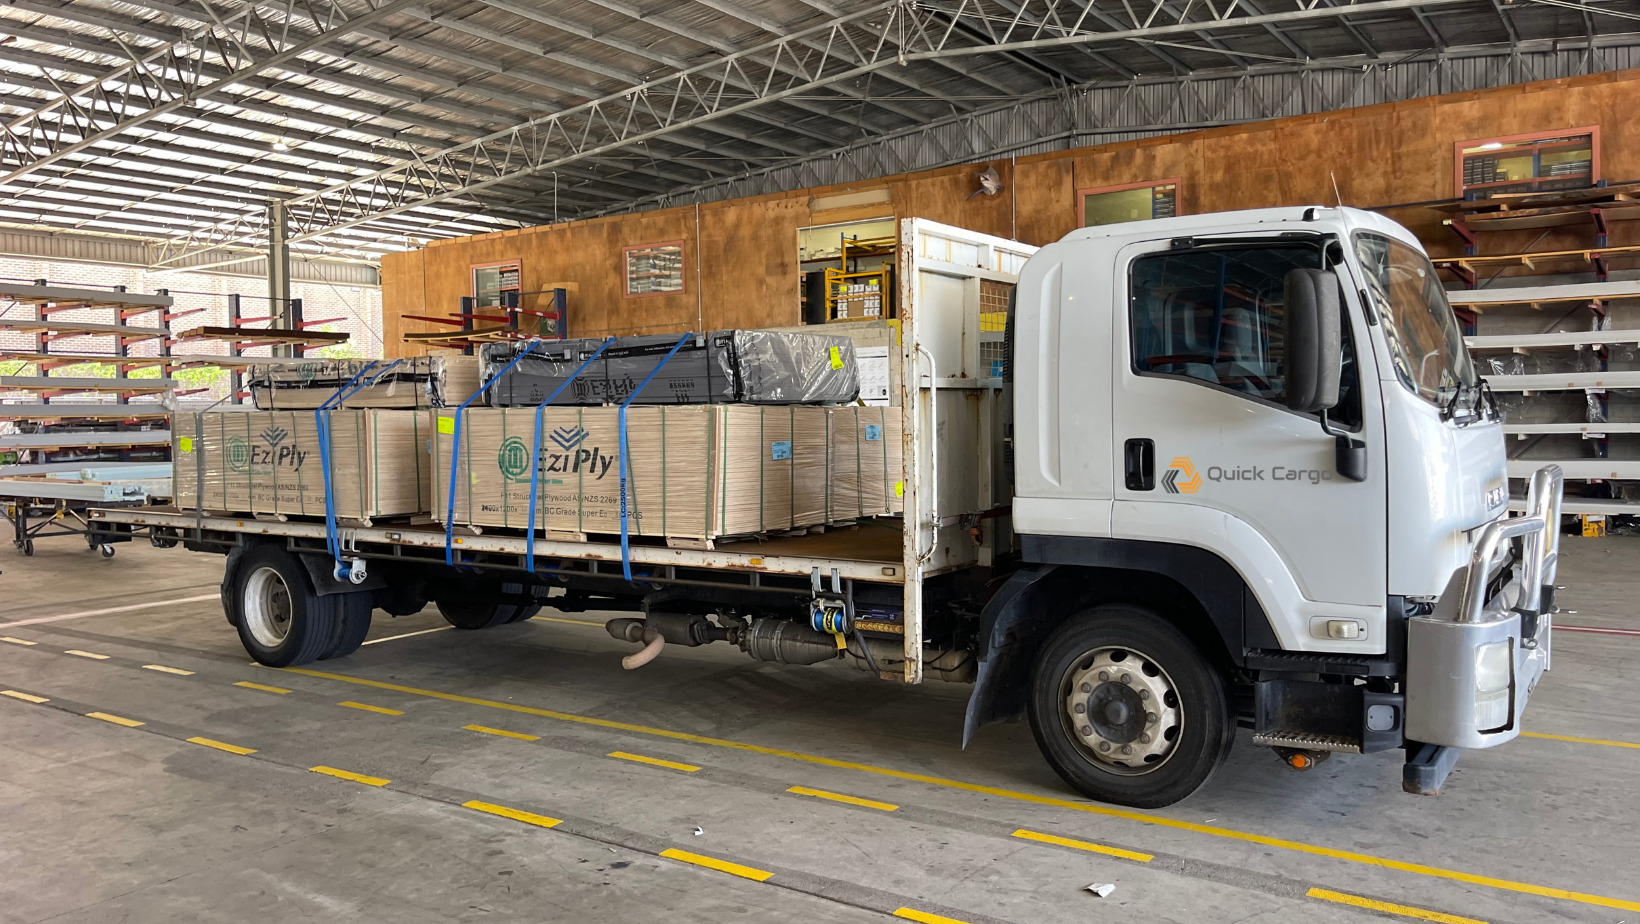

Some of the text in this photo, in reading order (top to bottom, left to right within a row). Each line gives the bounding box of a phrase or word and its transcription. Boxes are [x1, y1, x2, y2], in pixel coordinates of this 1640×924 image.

[1207, 466, 1333, 485] Quick Cargo
[258, 483, 275, 491] Plywoo
[266, 494, 281, 502] Grae
[544, 493, 573, 503] Plywood
[573, 494, 599, 503] AS/NZS
[600, 495, 617, 504] 2269
[544, 507, 555, 515] BC
[555, 507, 577, 516] Grade
